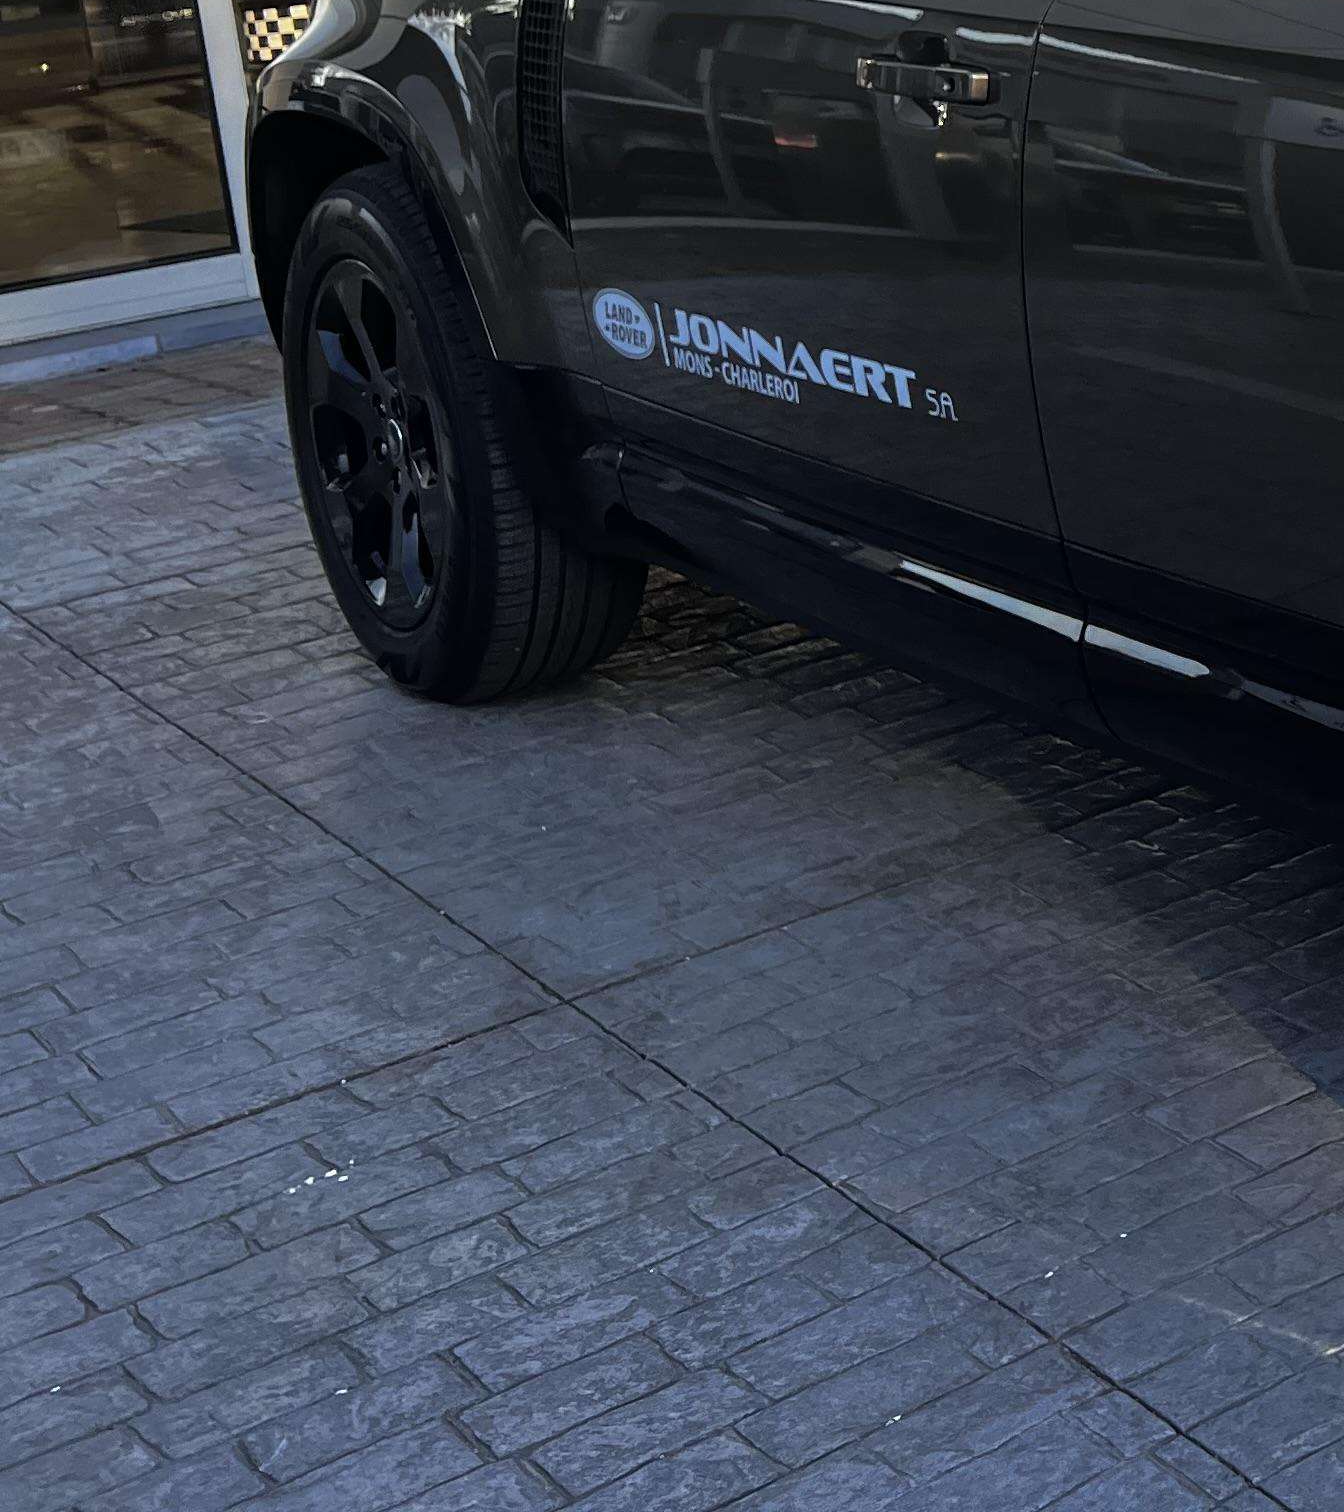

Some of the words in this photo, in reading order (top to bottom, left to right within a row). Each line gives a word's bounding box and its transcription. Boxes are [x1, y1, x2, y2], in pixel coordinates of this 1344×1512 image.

[604, 300, 633, 326] LAND
[609, 322, 647, 350] ROVER
[669, 308, 917, 410] JONNAERT
